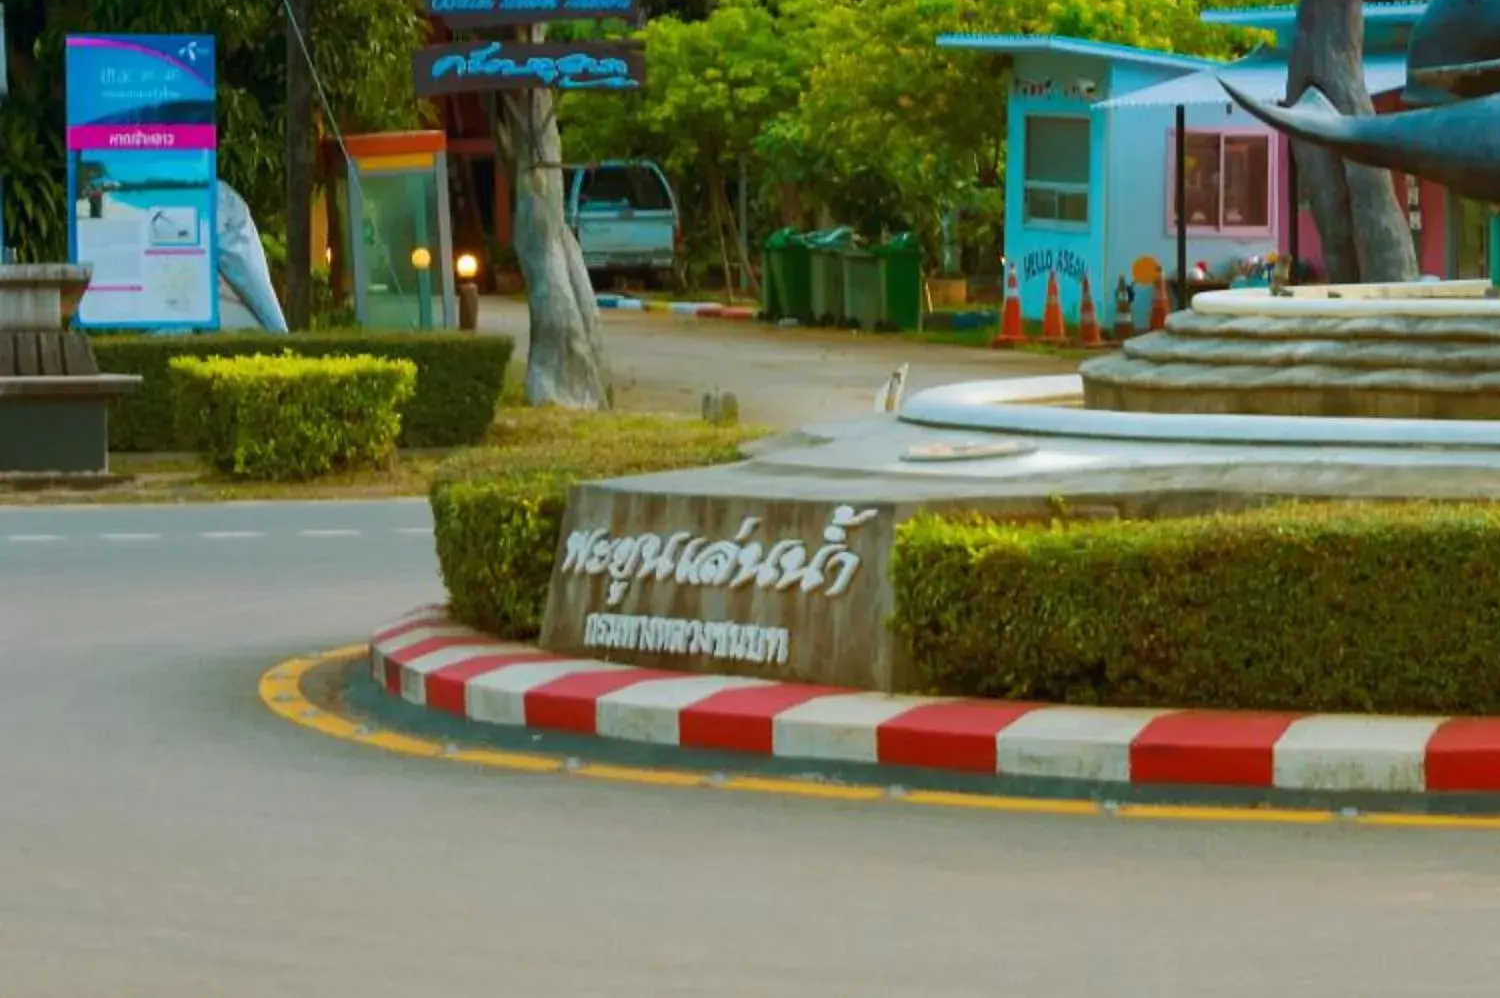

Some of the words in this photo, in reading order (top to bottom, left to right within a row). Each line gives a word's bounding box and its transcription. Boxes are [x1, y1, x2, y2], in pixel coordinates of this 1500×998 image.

[562, 504, 879, 605] พะยูนเล่นน้ำ
[584, 611, 790, 664] กรมทางหลวงชนบท
